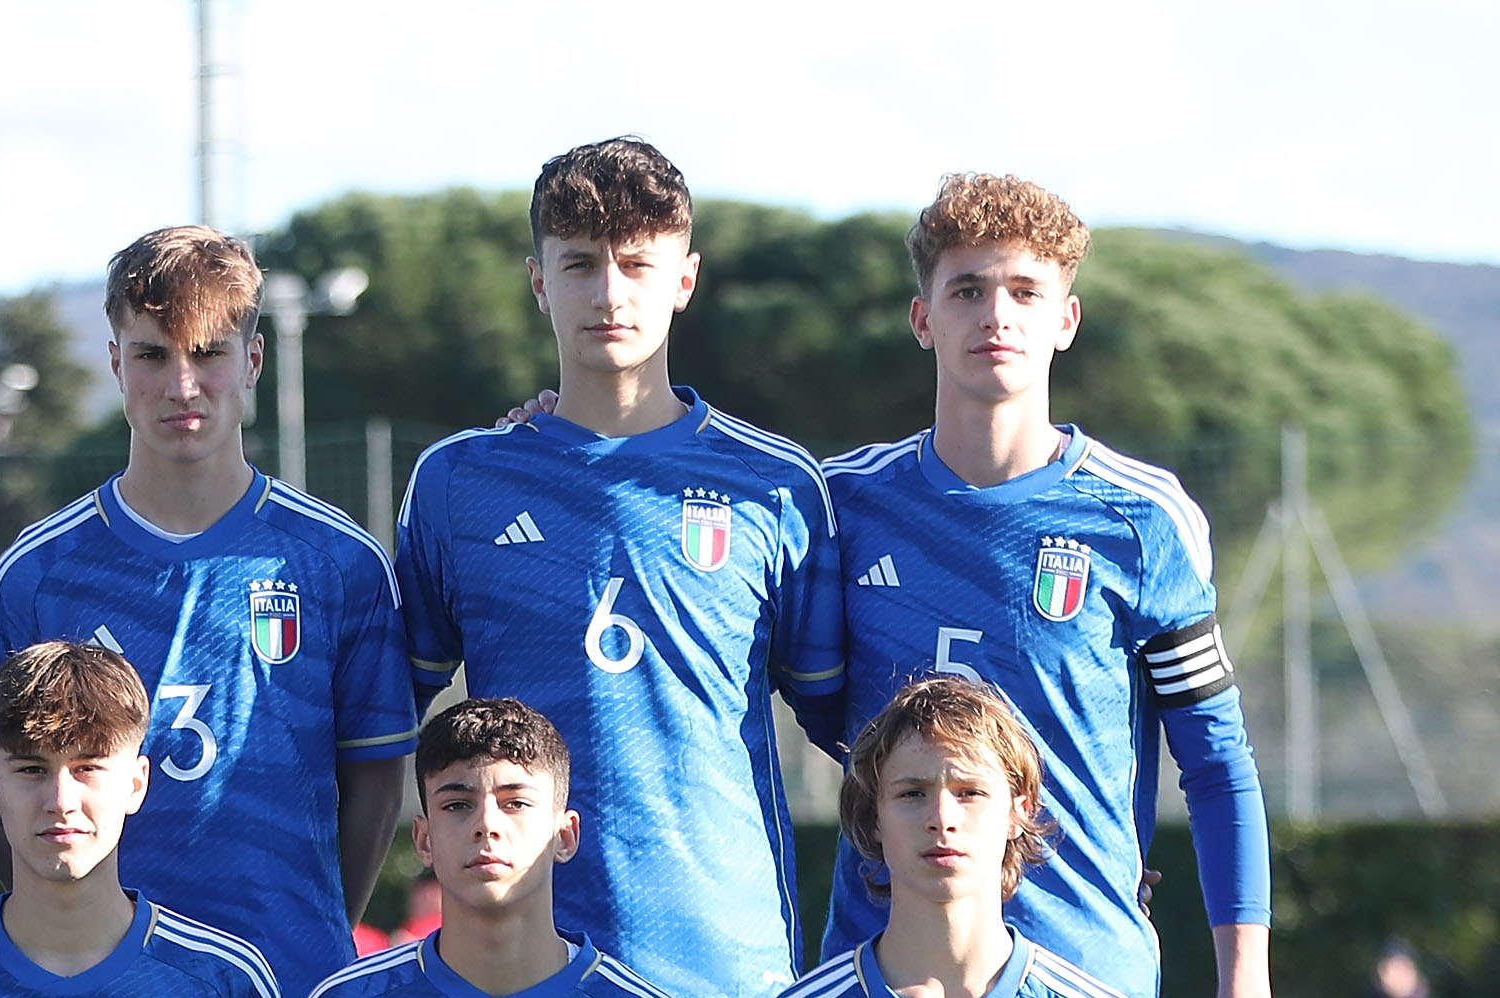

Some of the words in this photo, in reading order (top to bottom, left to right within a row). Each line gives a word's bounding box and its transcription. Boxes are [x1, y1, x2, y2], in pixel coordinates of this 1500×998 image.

[687, 505, 726, 521] ITALIA
[1042, 554, 1083, 573] ITALIA
[254, 598, 295, 612] ITALIA
[584, 577, 645, 674] 6
[159, 684, 217, 782] 3
